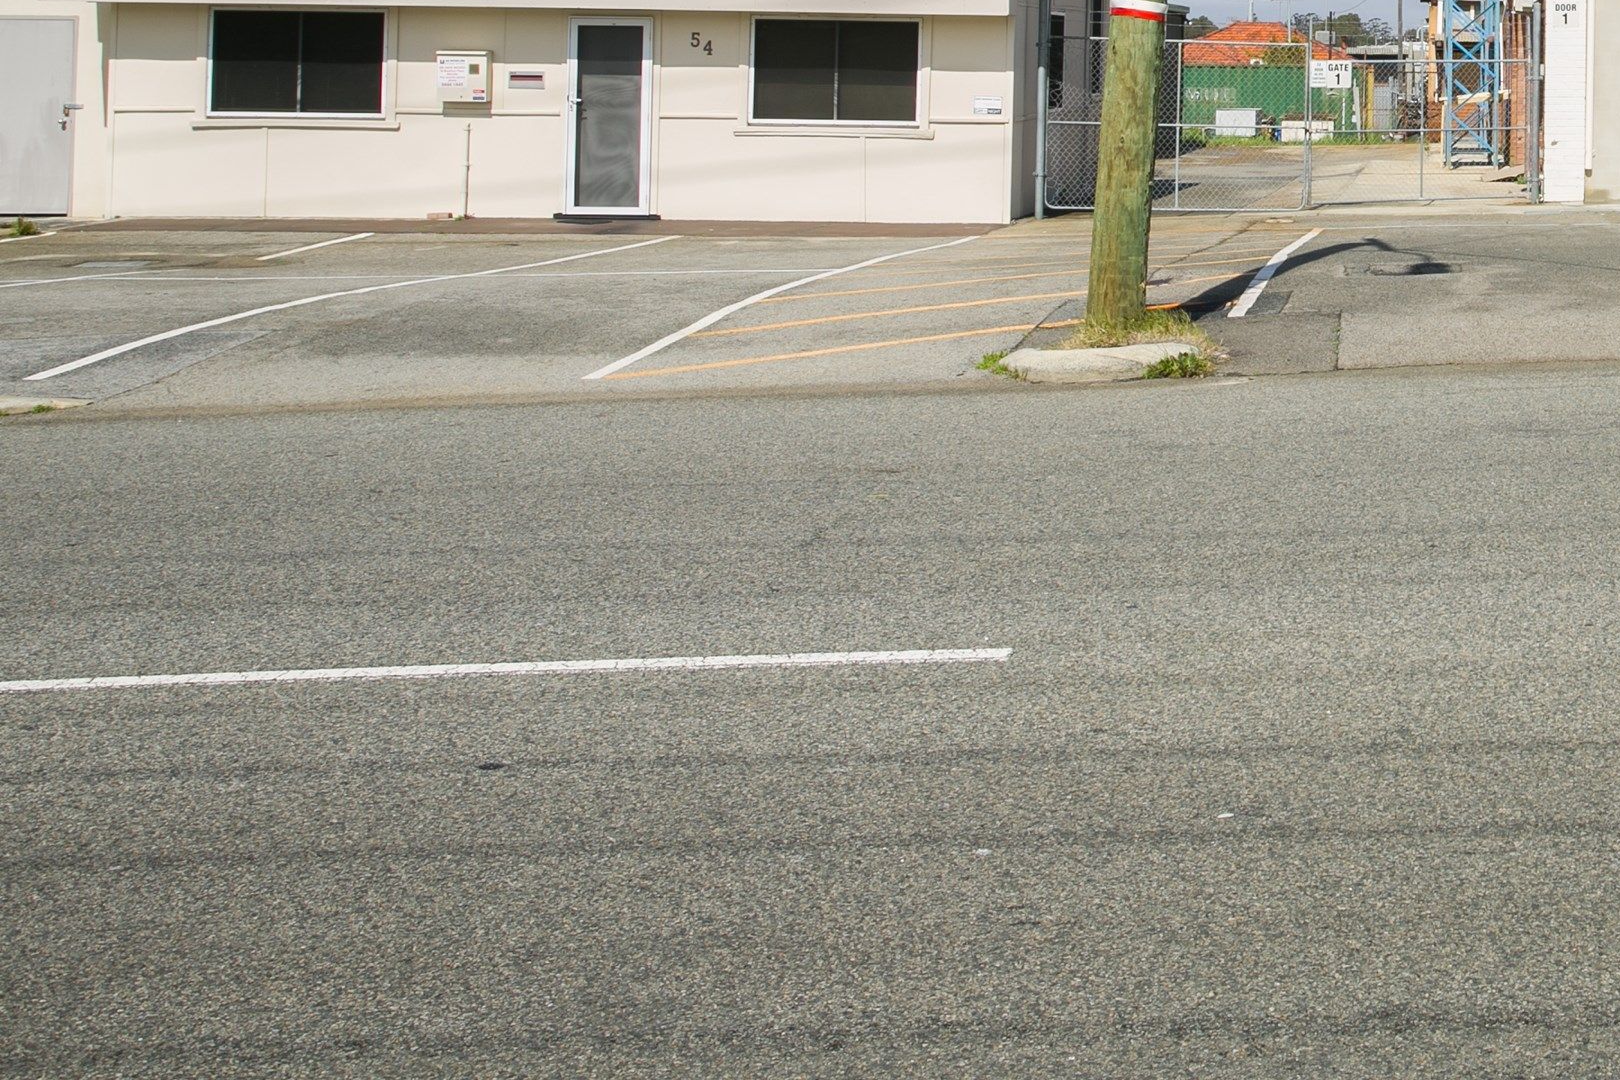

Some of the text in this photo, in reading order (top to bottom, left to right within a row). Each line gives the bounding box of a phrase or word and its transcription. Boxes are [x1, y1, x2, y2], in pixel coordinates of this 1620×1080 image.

[1555, 3, 1577, 12] DOOR
[1562, 13, 1568, 25] 1
[1328, 63, 1349, 72] GATE
[1335, 73, 1340, 85] 1
